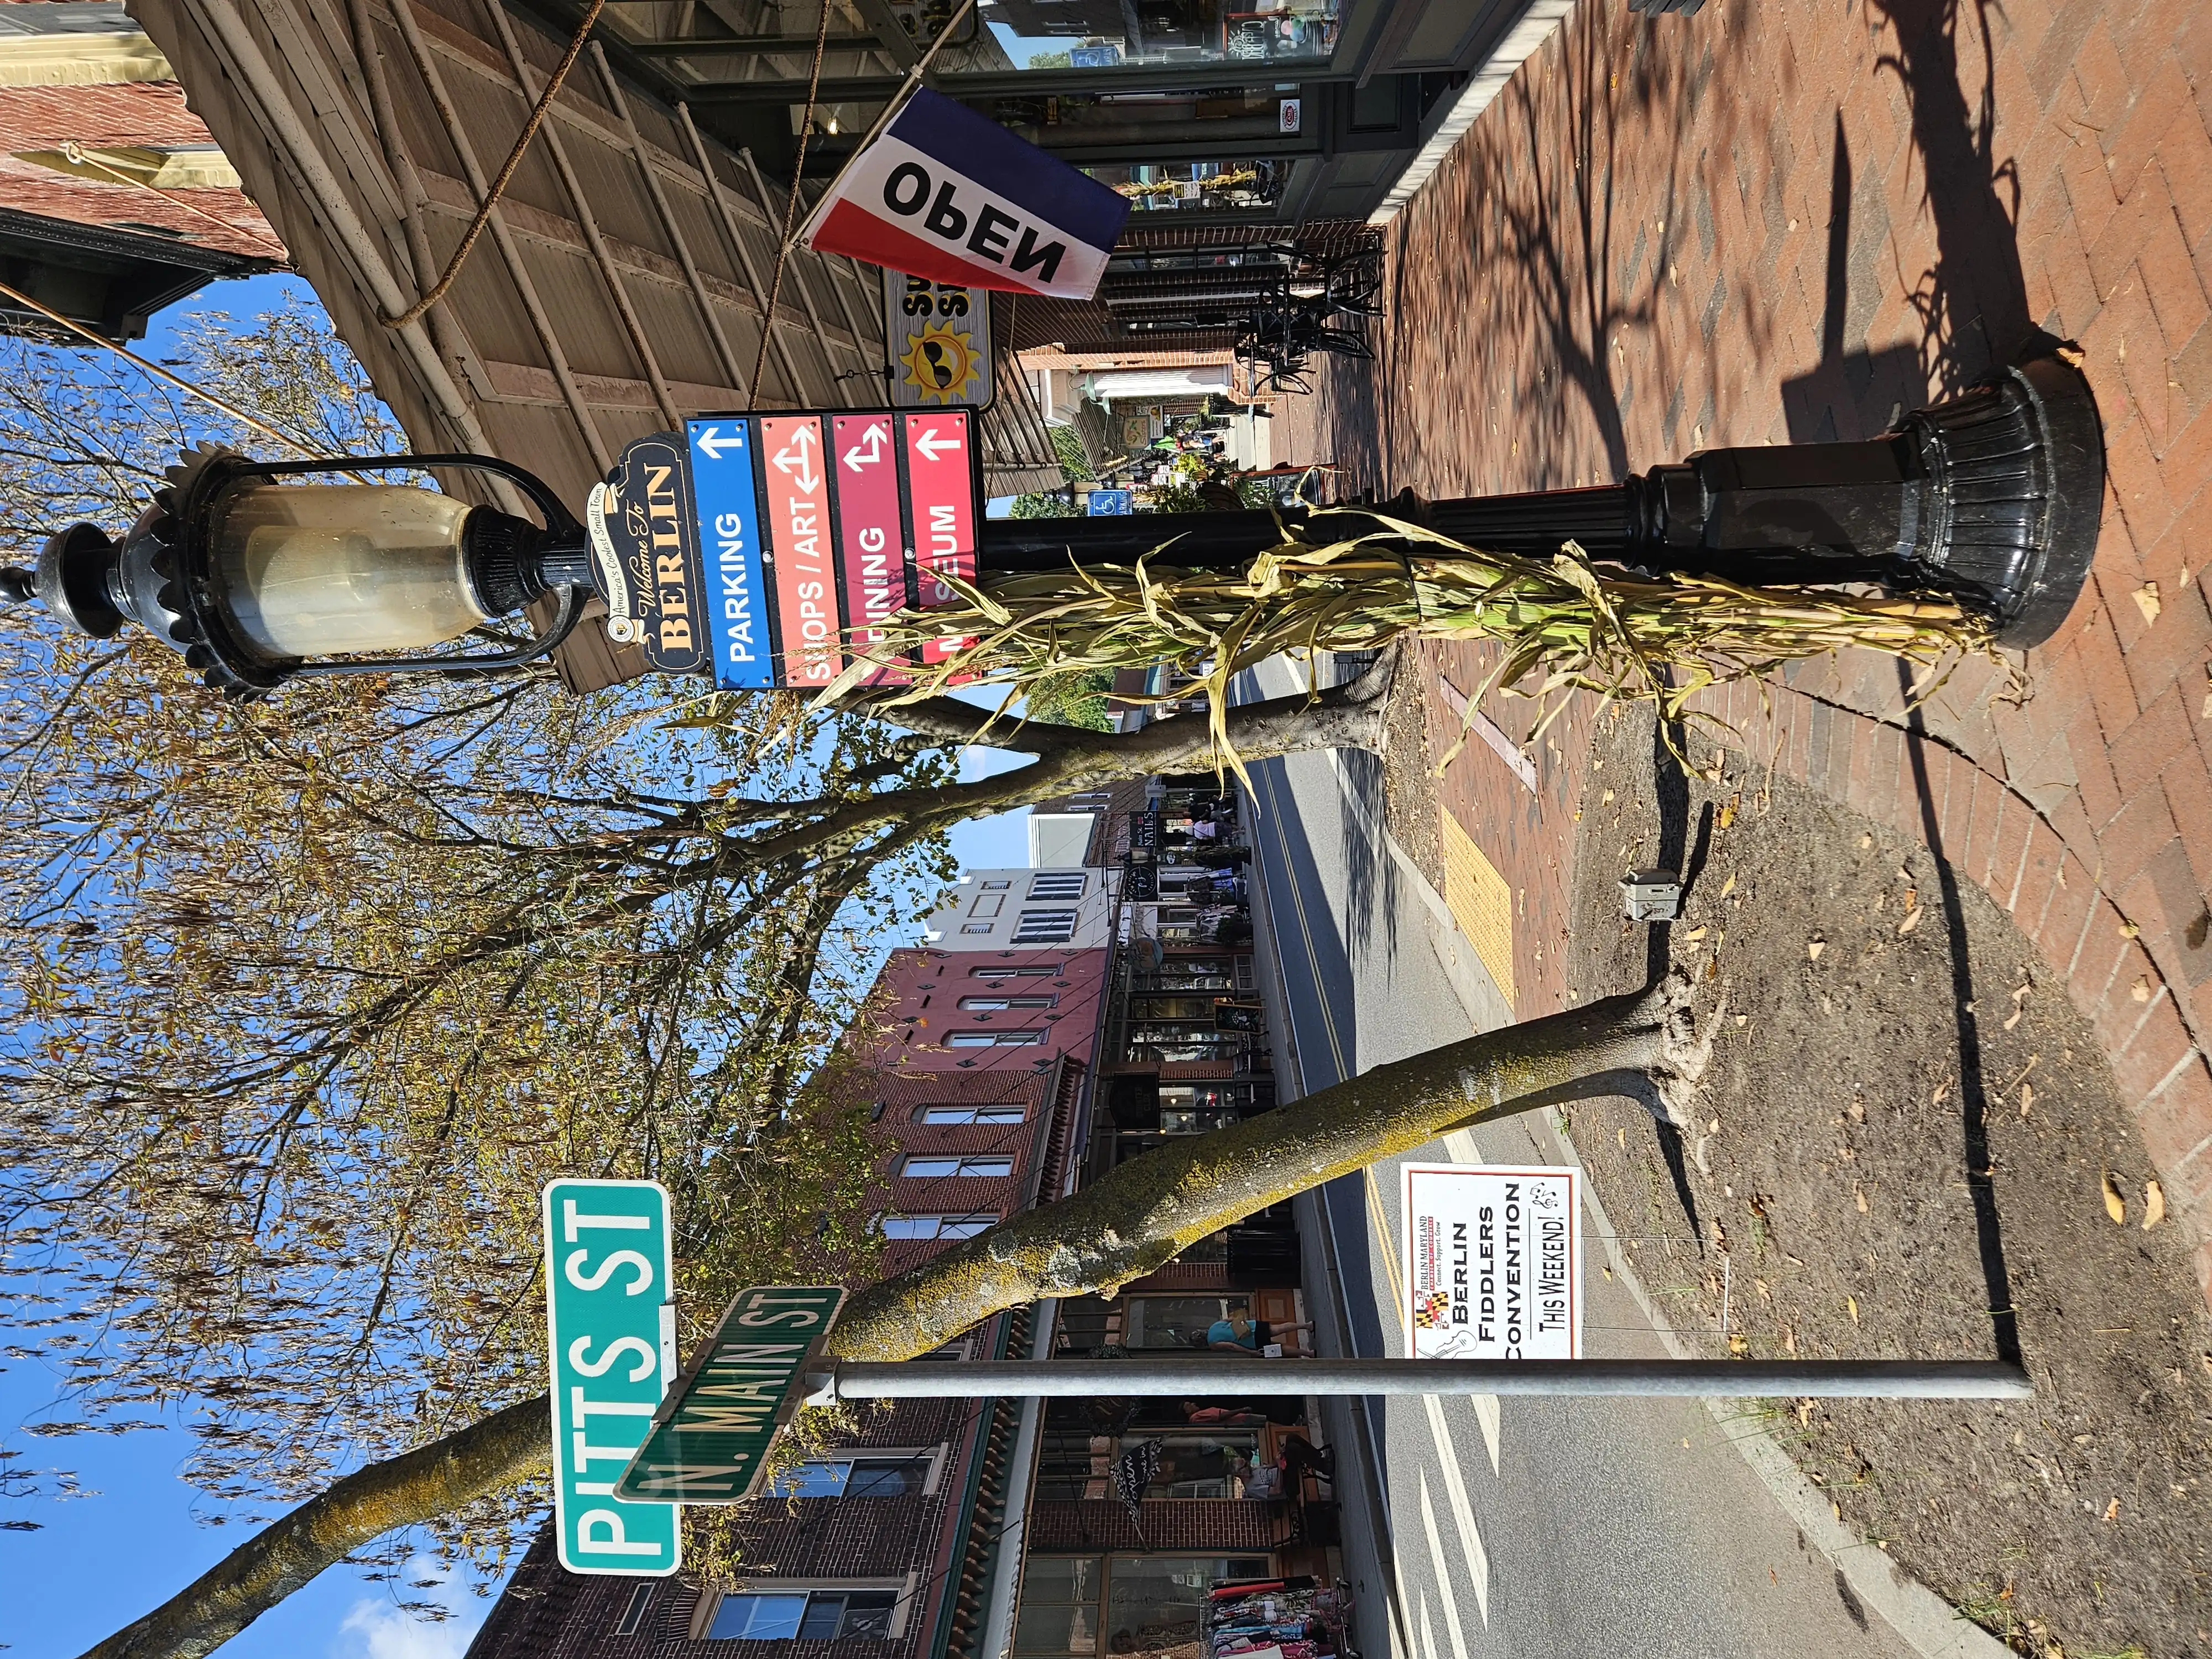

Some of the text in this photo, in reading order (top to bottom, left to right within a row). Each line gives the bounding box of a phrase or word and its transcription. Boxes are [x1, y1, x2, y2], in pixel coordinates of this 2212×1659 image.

[589, 488, 603, 508] Town
[589, 510, 604, 535] Small
[790, 497, 820, 557] ART
[1119, 492, 1128, 514] ARKING
[598, 538, 617, 568] Coolest
[611, 571, 626, 613] America's
[626, 499, 656, 616] Welcome To
[643, 462, 692, 653] BERLIN
[714, 513, 755, 662] PARKING
[929, 505, 963, 651] MSEUM
[797, 582, 831, 680] SHOPS
[1144, 812, 1154, 846] NAILS
[564, 1199, 653, 1296] ST
[1420, 1216, 1428, 1290] BERLIN MARYLAND
[1452, 1222, 1468, 1324] BERLIN
[1479, 1206, 1495, 1342] FIDDLERS
[1505, 1183, 1522, 1359] CONVENTION
[1537, 1217, 1565, 1332] THIS WEEKEND!
[637, 1294, 827, 1490] N. MAIN ST
[1125, 1454, 1138, 1500] open
